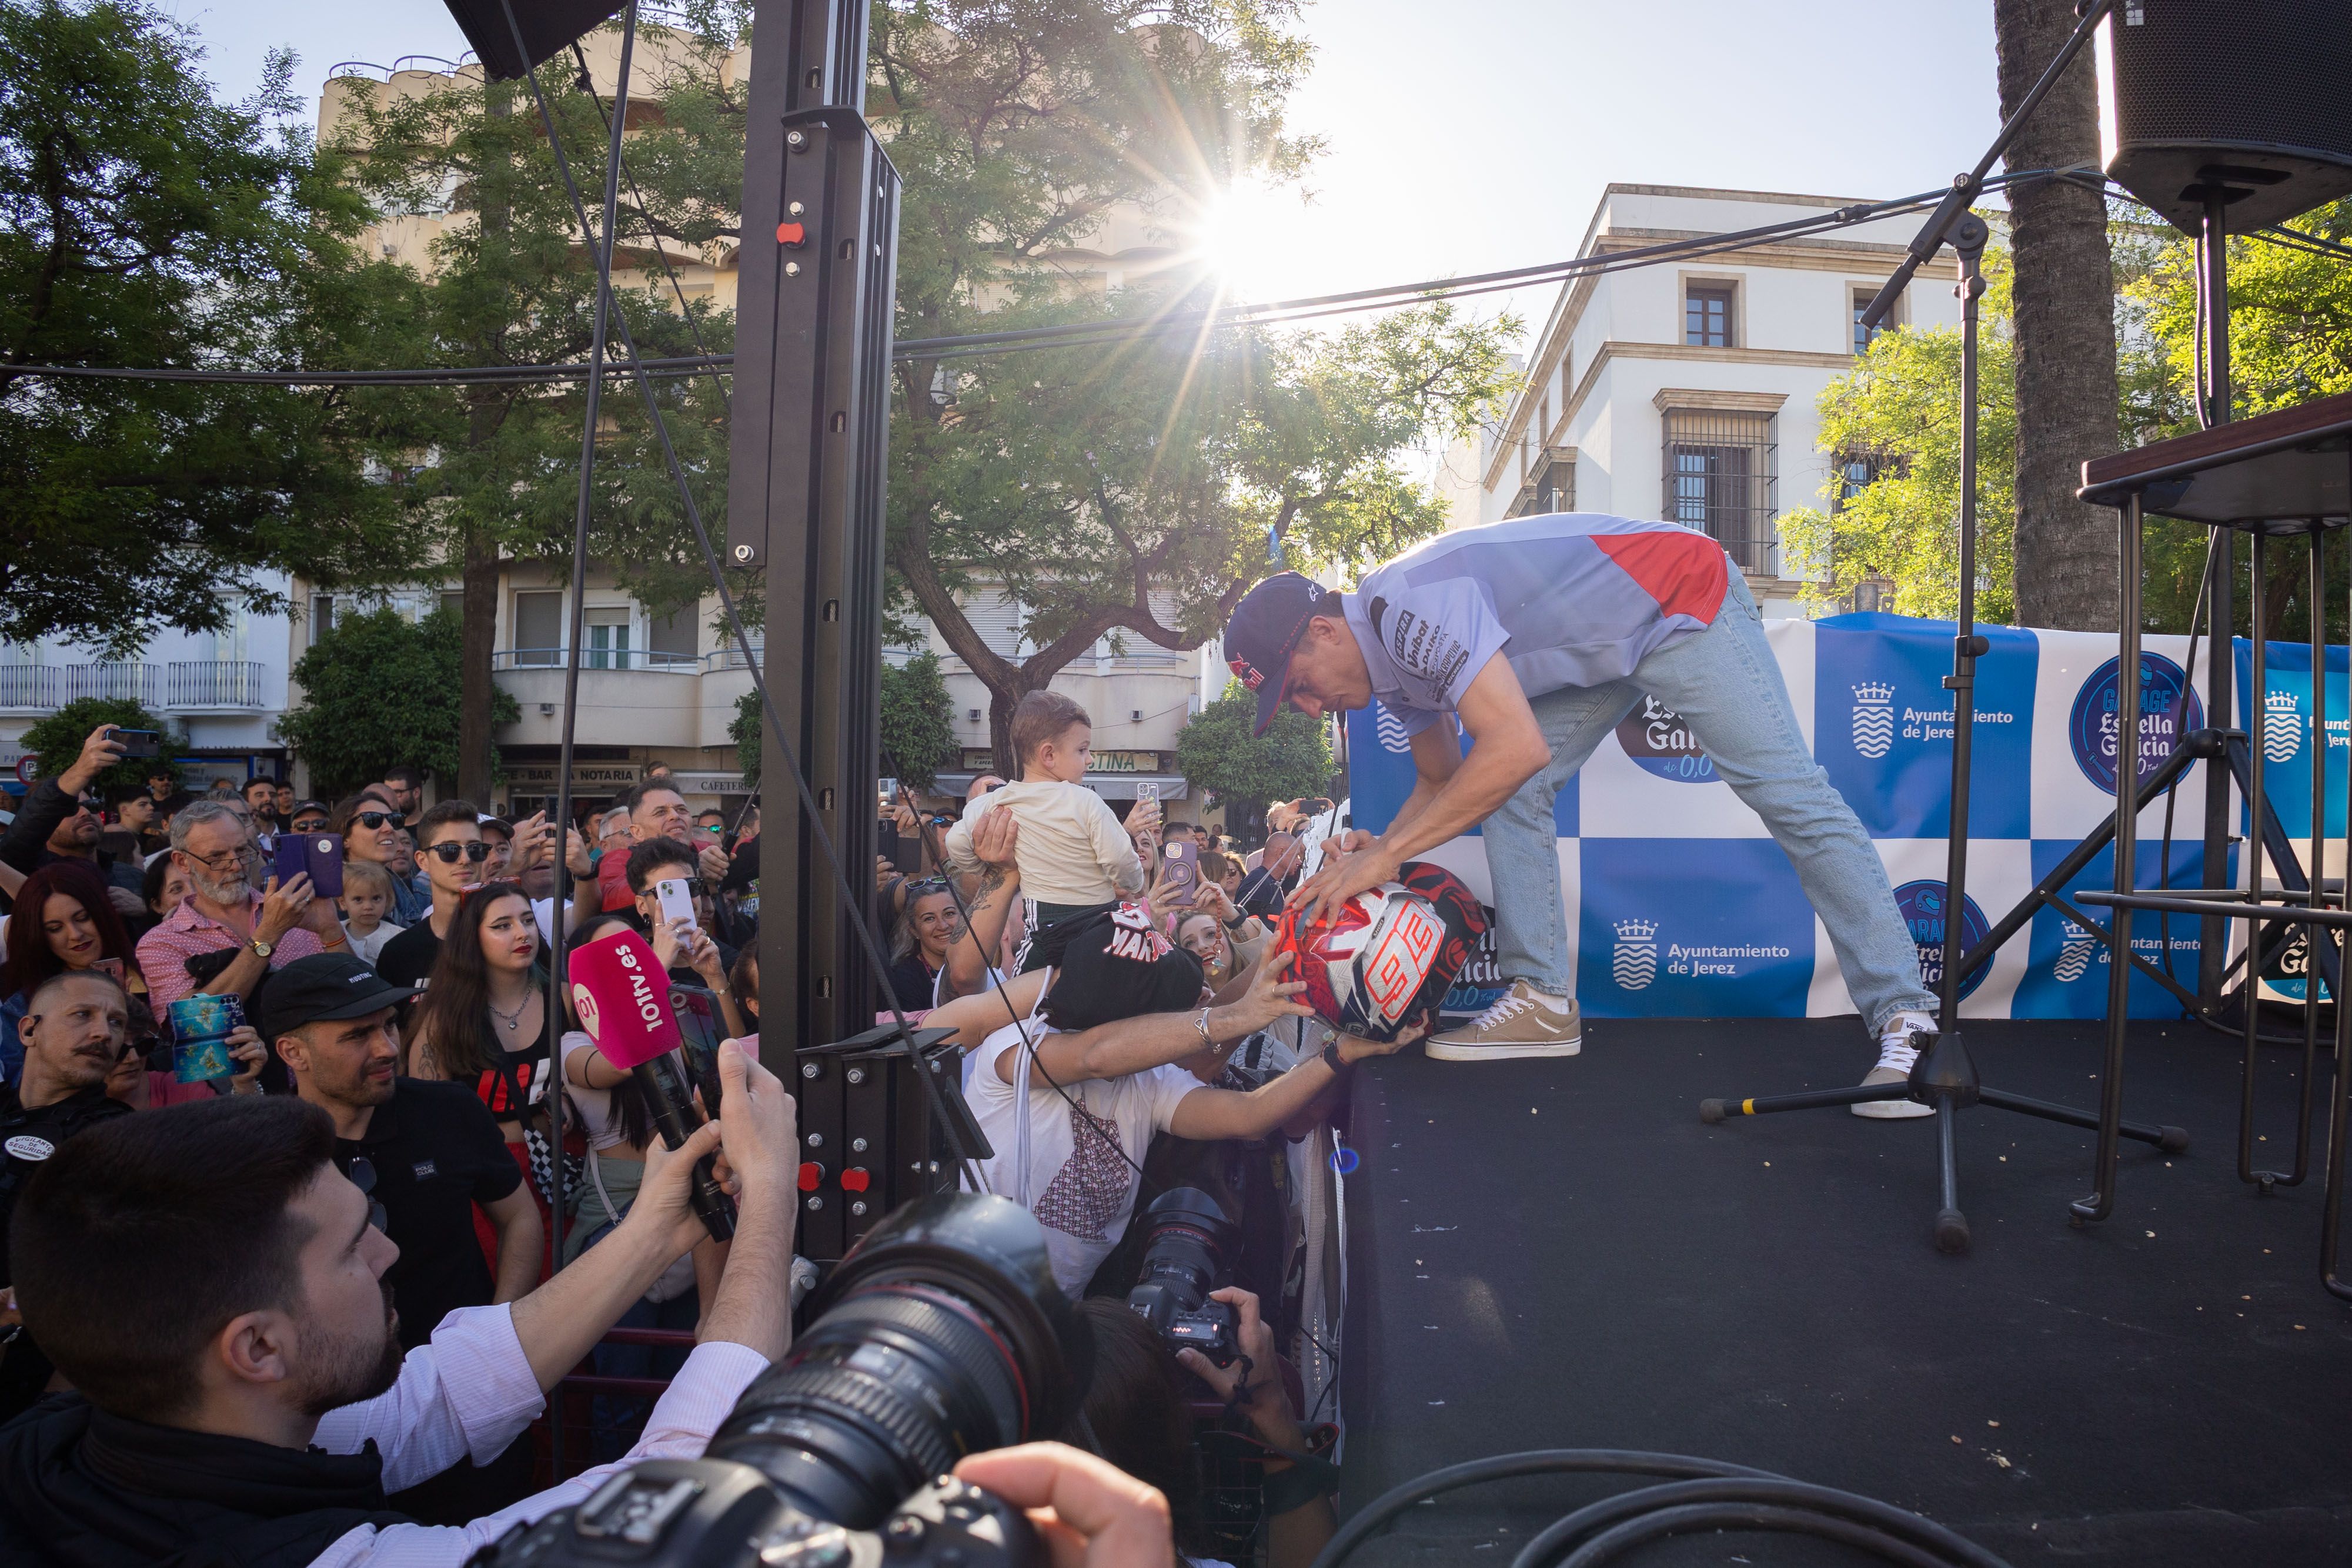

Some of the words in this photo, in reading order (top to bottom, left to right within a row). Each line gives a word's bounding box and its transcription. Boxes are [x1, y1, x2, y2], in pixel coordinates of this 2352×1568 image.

[1396, 612, 1411, 657] ASPIRA
[1407, 619, 1429, 668] Unibat
[1422, 624, 1441, 666] DAIKO
[1447, 655, 1467, 684] MICHELIN
[2103, 688, 2171, 713] GAGE
[1902, 707, 2013, 725] Ayuntaiento
[2098, 712, 2174, 734] Esella
[1902, 724, 1921, 738] de
[1923, 724, 1955, 741] Jere
[2327, 733, 2351, 748] Jere
[2101, 734, 2170, 757] Gicia
[1088, 753, 1135, 770] STINA
[1679, 753, 1713, 778] 0,0
[529, 770, 553, 780] BAR
[580, 770, 634, 780] NOTARIA
[1372, 918, 1385, 938] SHOEI
[1668, 943, 1790, 961] Ayuntamiento
[1668, 961, 1689, 974] de
[1691, 961, 1736, 977] Jerez
[615, 944, 664, 1032] 101tv.es
[1906, 1021, 1925, 1032] VANS
[15, 1136, 53, 1152] VIGILANTE
